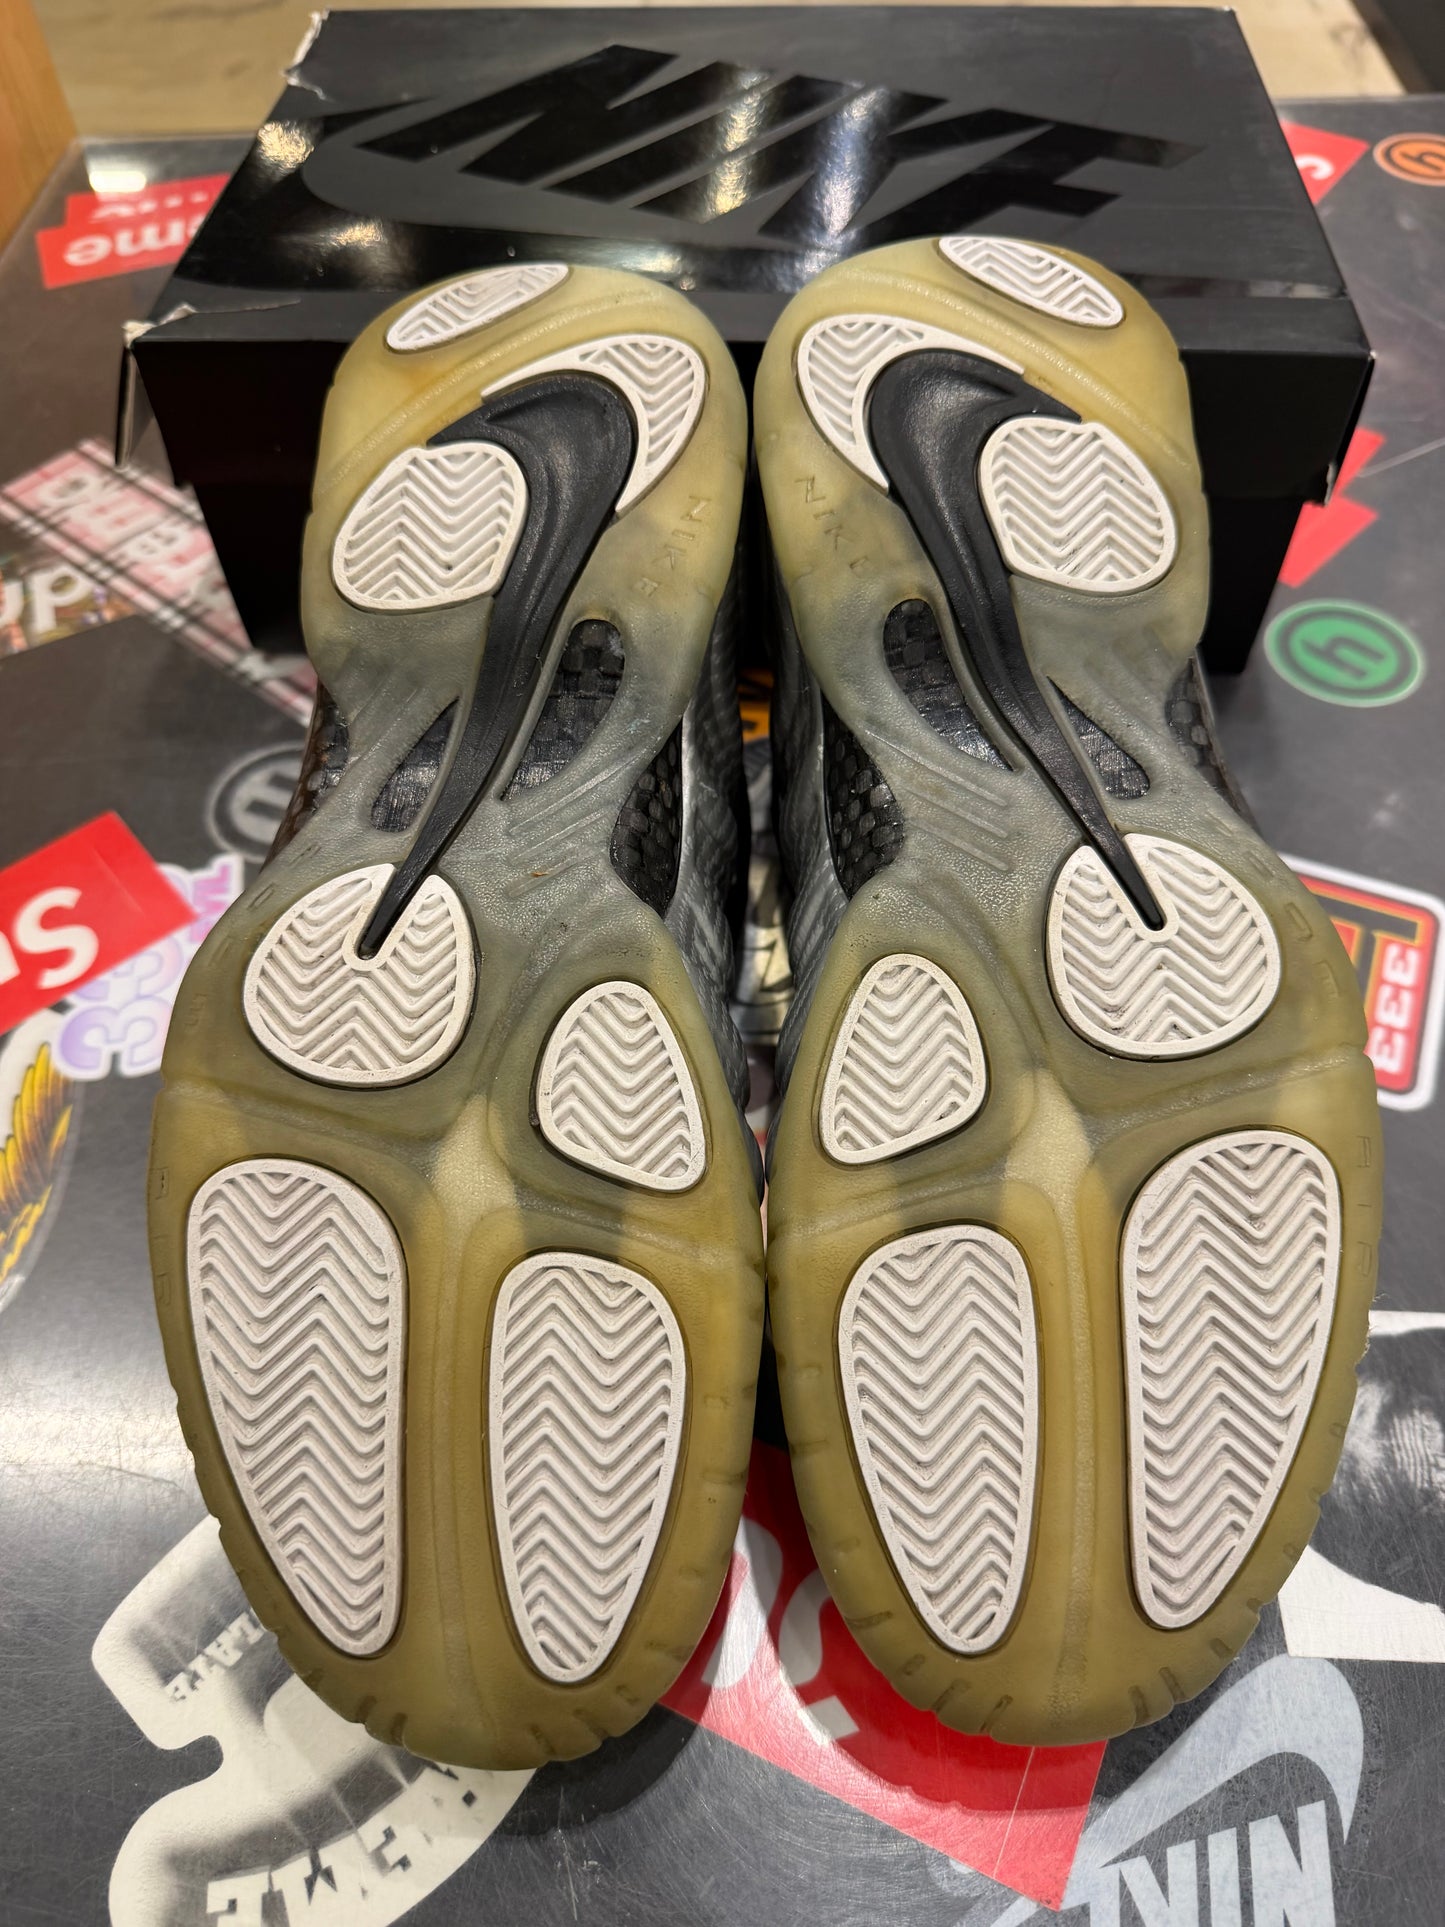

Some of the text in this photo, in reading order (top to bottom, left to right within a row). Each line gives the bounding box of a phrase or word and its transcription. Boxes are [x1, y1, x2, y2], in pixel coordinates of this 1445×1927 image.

[356, 44, 1204, 248] NIKE
[638, 494, 712, 598] NIKE
[794, 474, 870, 571] NIKE
[164, 1610, 266, 1704] LATE
